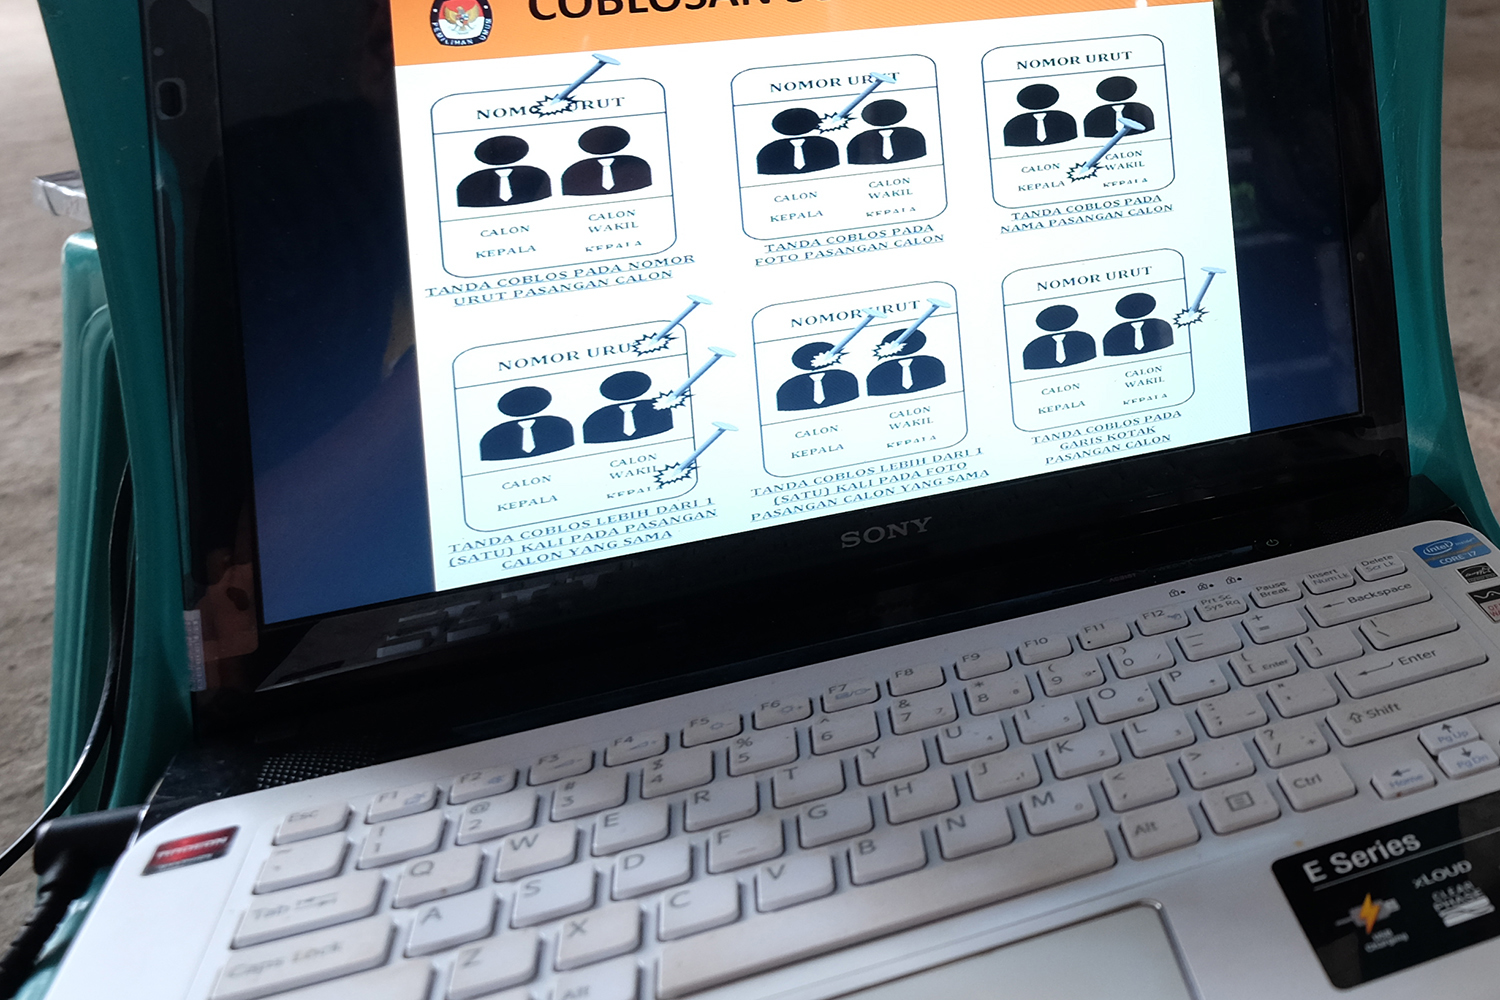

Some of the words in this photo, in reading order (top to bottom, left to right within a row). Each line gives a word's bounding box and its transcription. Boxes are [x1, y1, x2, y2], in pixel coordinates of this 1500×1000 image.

[1016, 55, 1081, 70] NOMOR
[1085, 50, 1133, 63] URUT
[769, 77, 841, 93] NOMOR
[848, 71, 900, 86] URT
[476, 105, 543, 120] NOMO
[1105, 150, 1143, 161] CALON
[1021, 163, 1061, 174] CALON
[1105, 161, 1145, 171] WAKIL
[868, 177, 911, 189] CALON
[1018, 180, 1066, 192] KEPALA
[774, 191, 818, 203] CALON
[868, 189, 913, 200] WAKIL
[588, 209, 636, 222] CALON
[1010, 207, 1062, 221] TANDA
[1066, 200, 1120, 213] COBLOS
[1124, 195, 1163, 205] PADA
[770, 210, 823, 222] KEPALA
[1000, 221, 1044, 234] NAMA
[1049, 210, 1124, 227] PASANGAN
[1128, 204, 1173, 217] CALON
[480, 225, 530, 238] CALON
[588, 221, 639, 234] WAKIL
[764, 237, 821, 253] TANDA
[826, 229, 887, 244] COBLOS
[892, 224, 934, 236] PADA
[475, 245, 537, 259] KEPALA
[754, 252, 799, 267] FOTO
[804, 241, 888, 260] PASANGAN
[894, 234, 944, 248] CALON
[425, 281, 491, 297] TANDA
[497, 270, 568, 287] COBLOS
[574, 264, 622, 278] PADA
[628, 254, 696, 270] NOMOR
[1036, 273, 1101, 292] NOMOR
[1106, 265, 1153, 282] URUT
[453, 292, 508, 307] URUT
[513, 279, 609, 299] PASANGAN
[615, 270, 673, 284] CALON
[791, 308, 862, 328] NOMOR
[869, 300, 920, 314] RUT
[498, 350, 581, 371] NOMOR
[587, 342, 638, 358] URU
[1125, 365, 1163, 378] CALON
[1041, 383, 1081, 395] CALON
[1124, 376, 1165, 389] WAKIL
[889, 405, 932, 419] CALON
[1038, 399, 1086, 415] KEPALA
[888, 416, 934, 431] WAKIL
[1031, 428, 1082, 444] TANDA
[1086, 417, 1141, 434] COBLOS
[1144, 409, 1182, 424] PADA
[794, 424, 839, 439] CALON
[1059, 436, 1103, 451] GARIS
[1106, 426, 1156, 441] KOTAK
[791, 443, 845, 459] KEPALA
[1045, 443, 1121, 465] PASANGAN
[1125, 434, 1171, 450] CALON
[610, 453, 657, 467] CALON
[609, 465, 657, 479] WAKIL
[750, 479, 809, 498] TANDA
[813, 466, 876, 486] COBLOS
[881, 457, 927, 473] LEBIH
[932, 449, 972, 464] DARI
[502, 475, 552, 490] CALON
[773, 486, 830, 507] (SATU)
[836, 478, 873, 494] KALI
[879, 469, 922, 486] PADA
[925, 461, 967, 477] FOTO
[750, 496, 838, 522] PASANGAN
[843, 486, 897, 504] CALON
[901, 477, 942, 494] YANG
[947, 468, 990, 485] SAMA
[497, 494, 558, 512] KEPALA
[448, 534, 514, 554] TANDA
[519, 517, 591, 539] COBLOS
[596, 507, 650, 526] LEBIH
[655, 499, 701, 514] DARI
[840, 516, 933, 549] SONY
[448, 546, 514, 568] (SATU)
[521, 536, 565, 553] KALI
[570, 526, 620, 543] PADA
[625, 508, 718, 533] PASANGAN
[501, 551, 563, 571] CALON
[567, 542, 619, 560] YANG
[623, 529, 673, 548] SAMA
[1361, 554, 1394, 567] Delete
[1439, 554, 1463, 565] CORE
[1308, 568, 1338, 580] Insert
[1313, 575, 1337, 585] Num
[1256, 580, 1286, 592] Pause
[1260, 587, 1290, 598] Break
[1347, 582, 1412, 604] Backspace
[1142, 609, 1165, 620] F12
[1083, 623, 1106, 634] F11
[1024, 637, 1048, 650] F10
[961, 653, 981, 664] F9
[1262, 658, 1289, 671] Enter
[1398, 650, 1437, 666] Enter
[894, 668, 915, 679] F8
[828, 684, 847, 695] F7
[1366, 702, 1401, 719] Shift
[1293, 772, 1322, 791] Ctrl
[1134, 820, 1159, 837] Alt
[1302, 859, 1328, 885] E
[1329, 833, 1422, 875] Series
